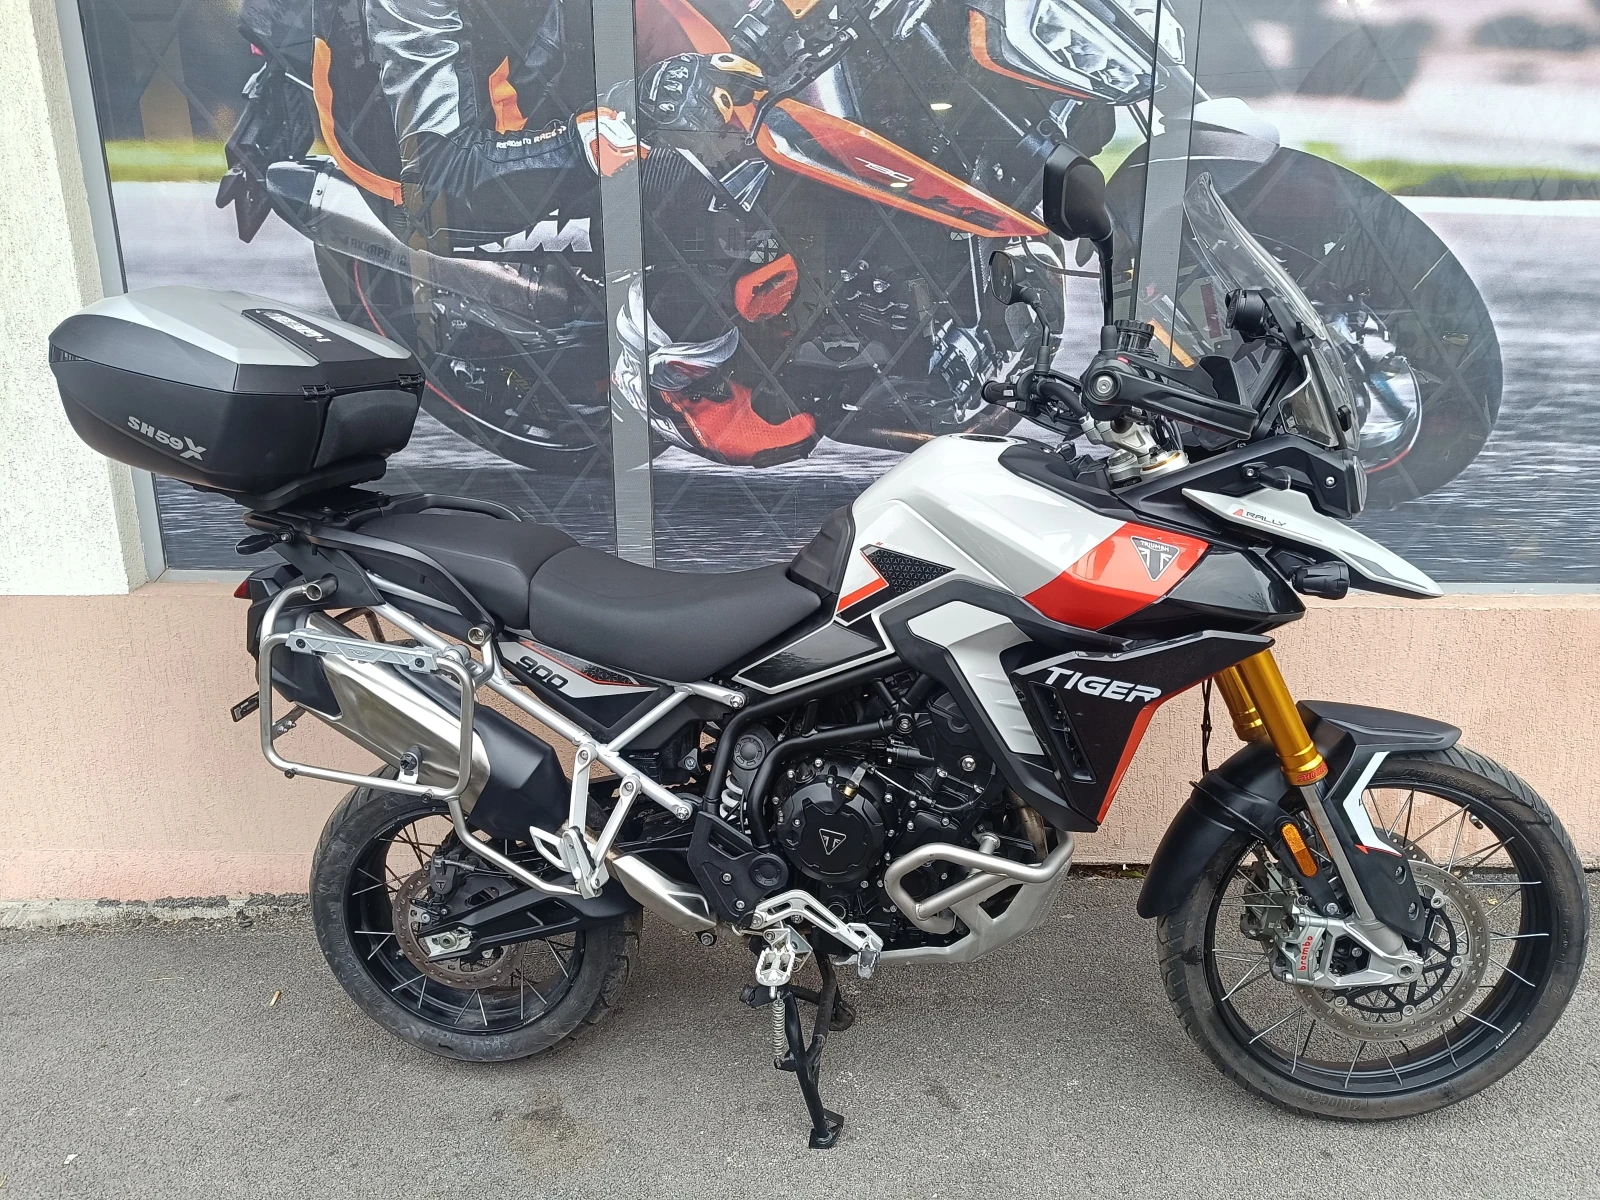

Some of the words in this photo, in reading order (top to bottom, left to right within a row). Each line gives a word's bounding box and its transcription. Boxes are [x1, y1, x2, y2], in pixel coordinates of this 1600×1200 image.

[127, 415, 207, 461] SH59X
[1245, 510, 1287, 527] RALLY
[1139, 540, 1170, 552] TRIUMPH
[516, 655, 569, 690] 900
[1044, 666, 1162, 703] TIGER
[1298, 935, 1313, 971] brembo
